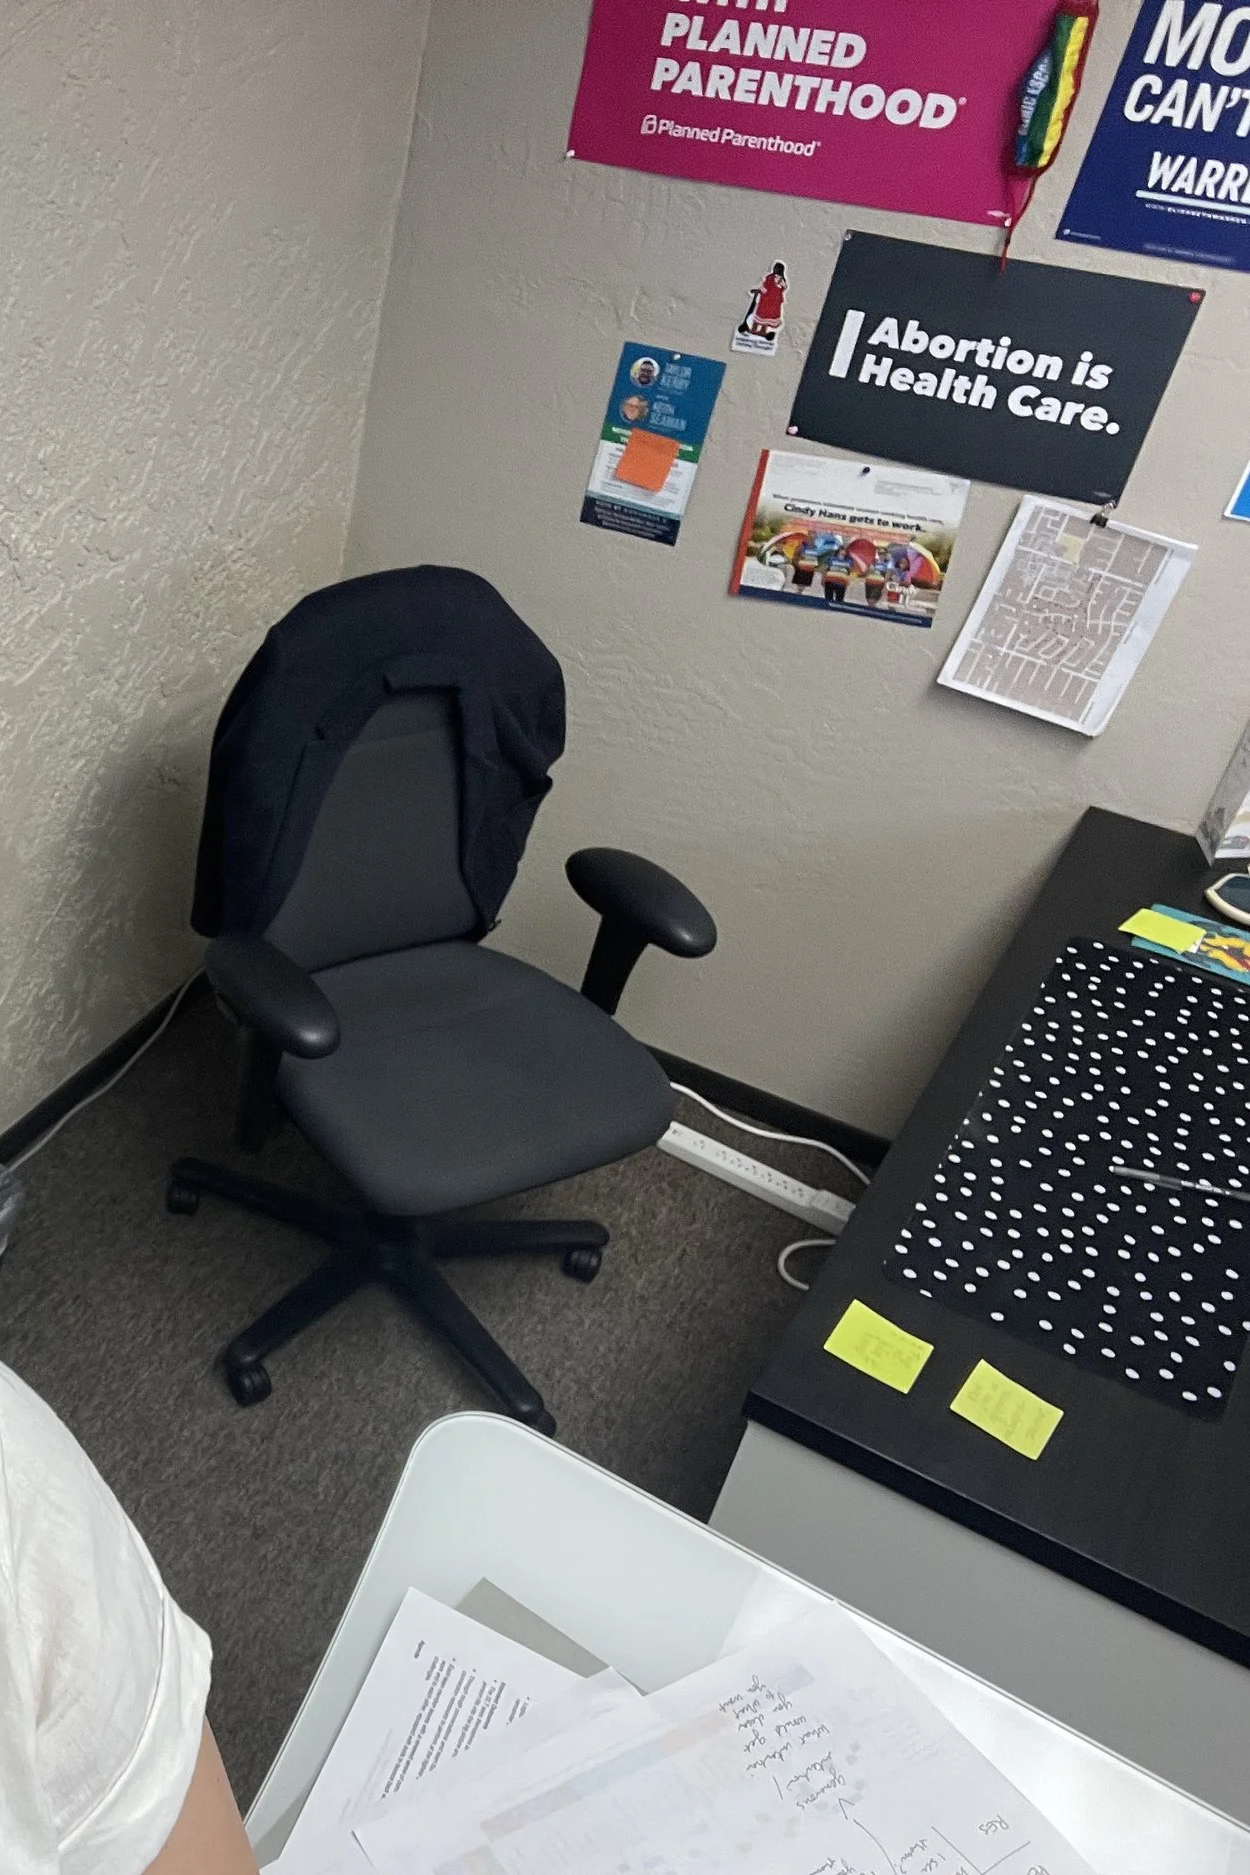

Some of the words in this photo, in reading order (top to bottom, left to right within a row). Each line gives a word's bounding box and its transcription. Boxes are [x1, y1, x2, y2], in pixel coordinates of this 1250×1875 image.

[661, 13, 867, 69] PLANNED
[1144, 0, 1250, 76] MO
[651, 57, 957, 129] PARENTHOOD
[657, 119, 721, 143] Planned
[720, 128, 817, 157] Parenthood
[867, 316, 1063, 376] Abortion
[1071, 350, 1113, 390] is
[858, 353, 998, 410] Health
[1007, 385, 1120, 435] Care.
[783, 503, 816, 517] Cindy
[849, 513, 875, 526] gets
[876, 516, 889, 526] to
[891, 518, 926, 533] work.
[746, 1674, 767, 1693] you
[765, 1689, 775, 1700] to
[718, 1693, 744, 1713] want
[732, 1698, 761, 1720] what
[772, 1691, 793, 1713] you
[775, 1715, 807, 1737] would
[742, 1728, 767, 1754] get
